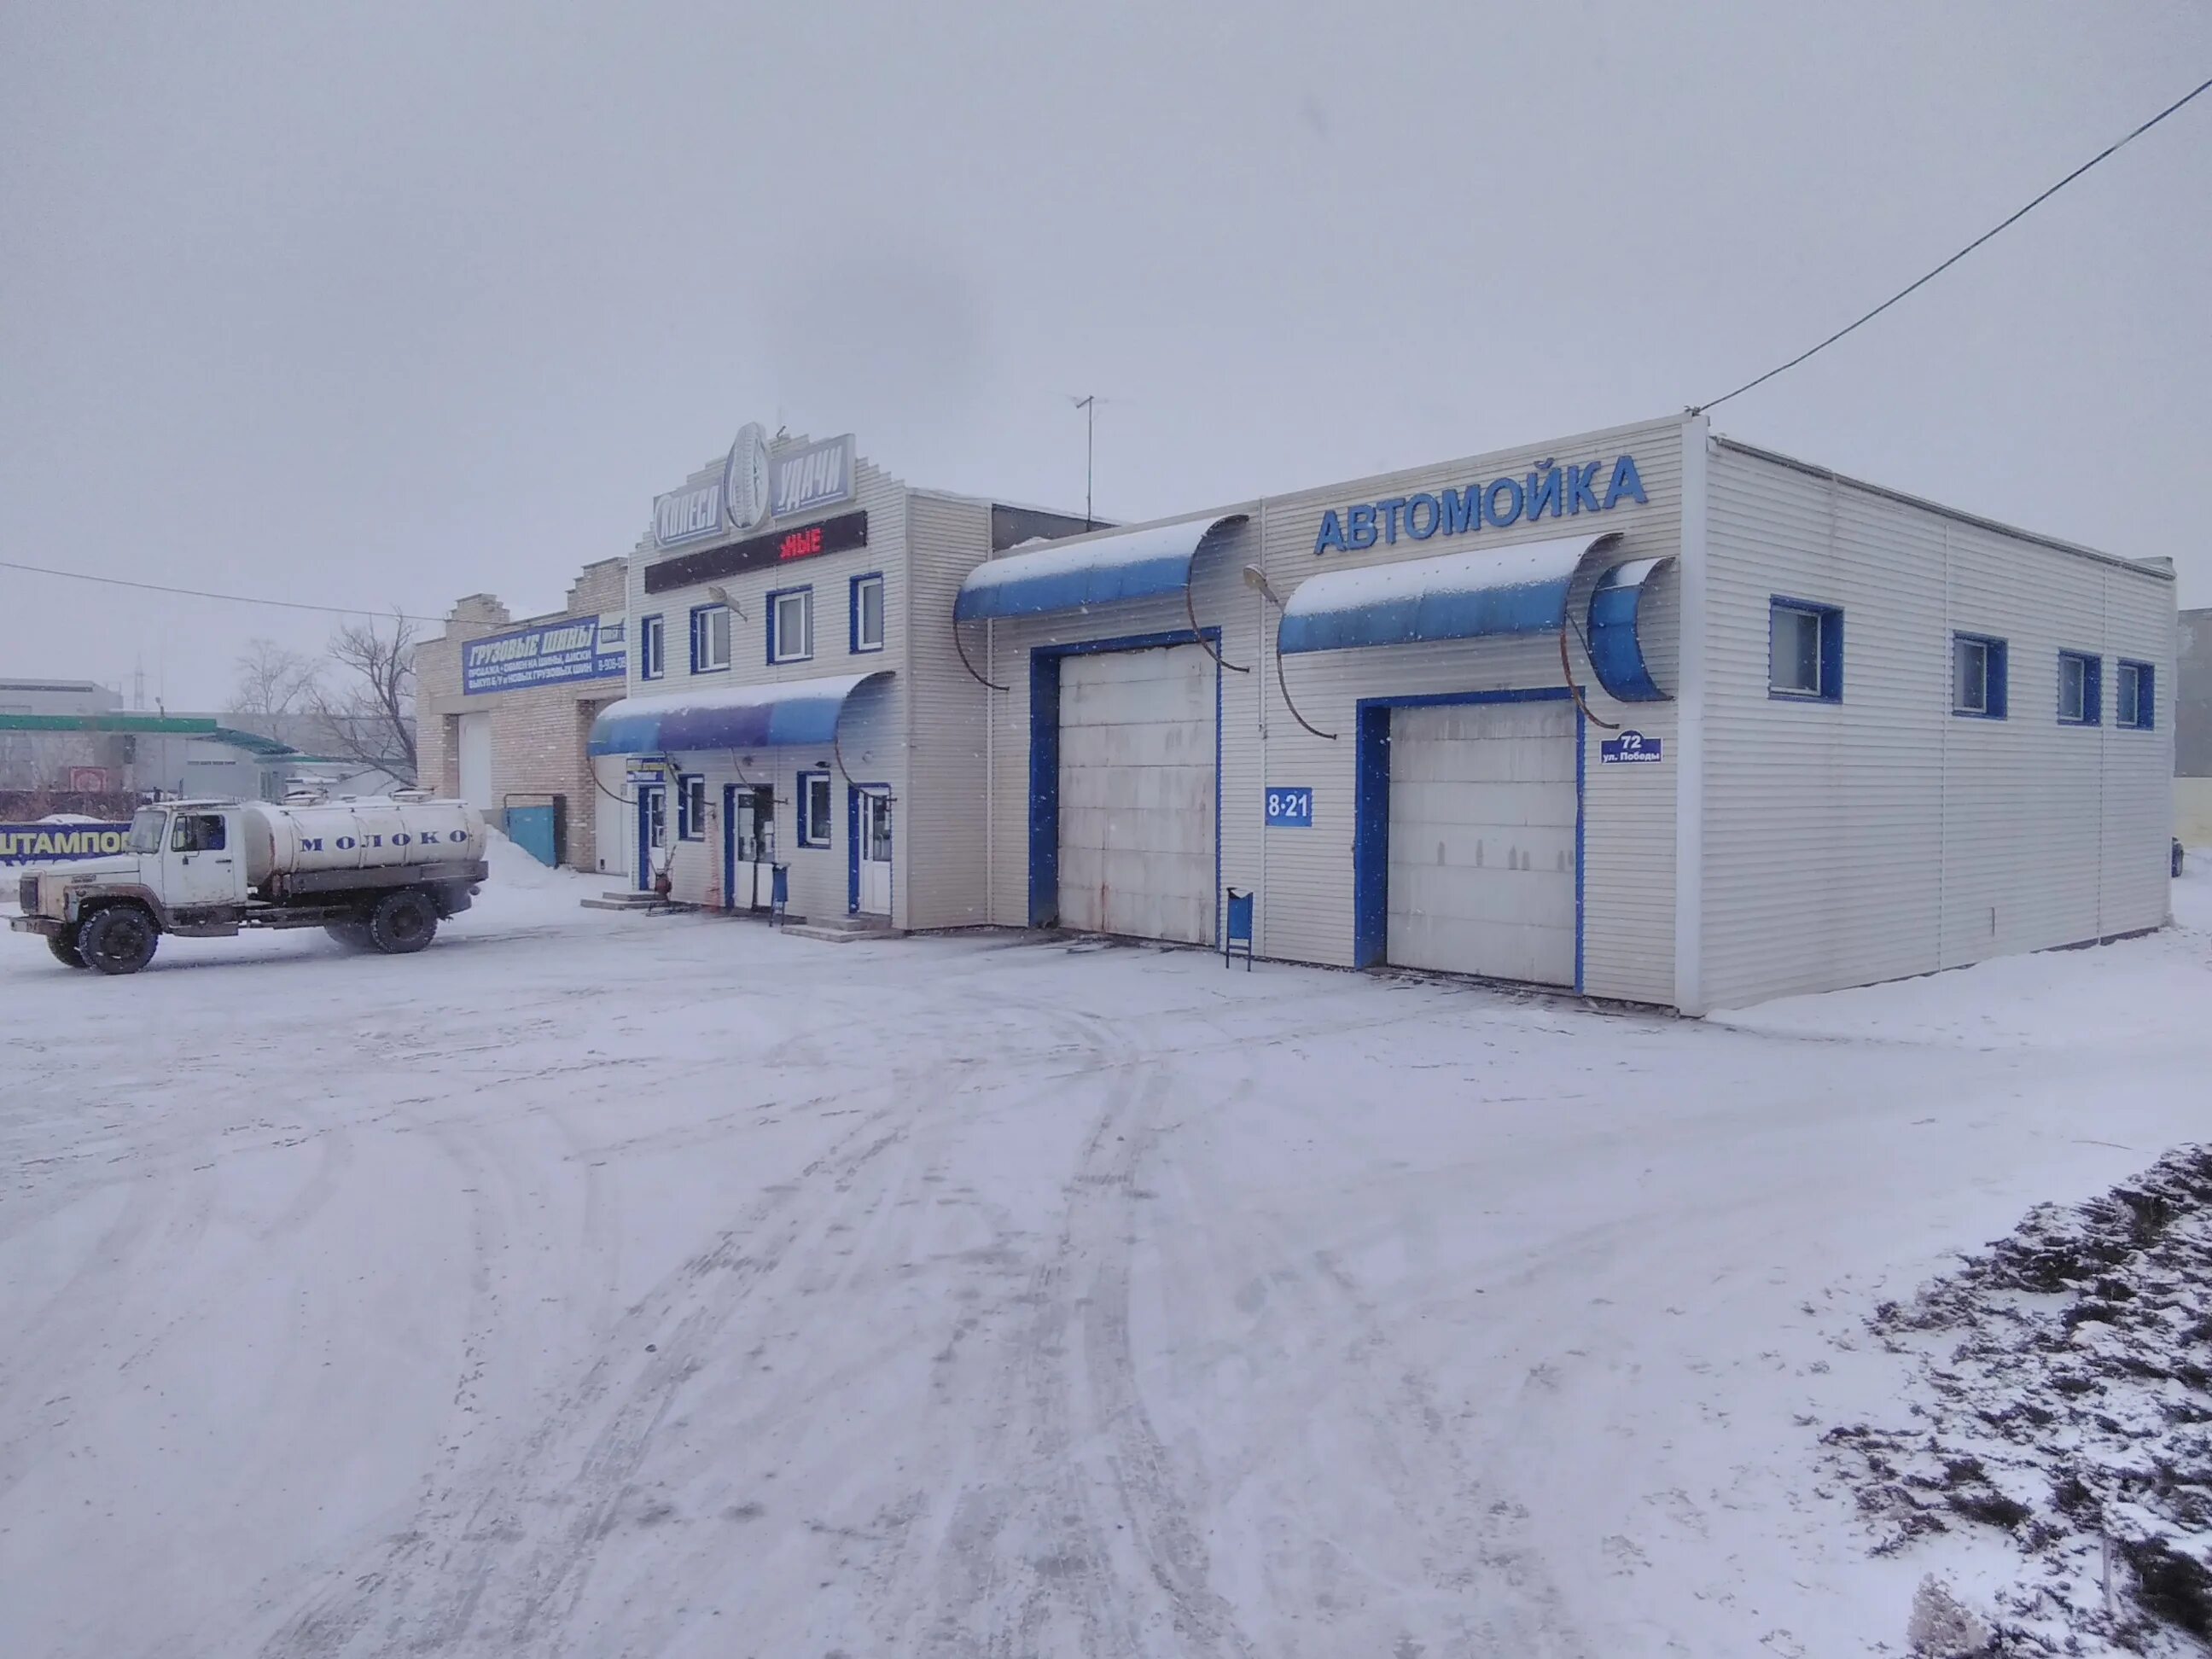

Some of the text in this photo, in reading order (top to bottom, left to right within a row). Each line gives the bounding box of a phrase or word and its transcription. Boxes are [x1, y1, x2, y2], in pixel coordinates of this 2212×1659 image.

[777, 444, 843, 512] УДАЧИ
[1313, 454, 1649, 556] АВТОМОЙКА
[469, 633, 540, 667] ГРУЗОВЫЕ
[541, 623, 596, 655] ШИНЫ
[1603, 751, 1660, 763] ул. Победы
[1620, 735, 1642, 749] 72
[299, 829, 469, 853] МОЛОКО
